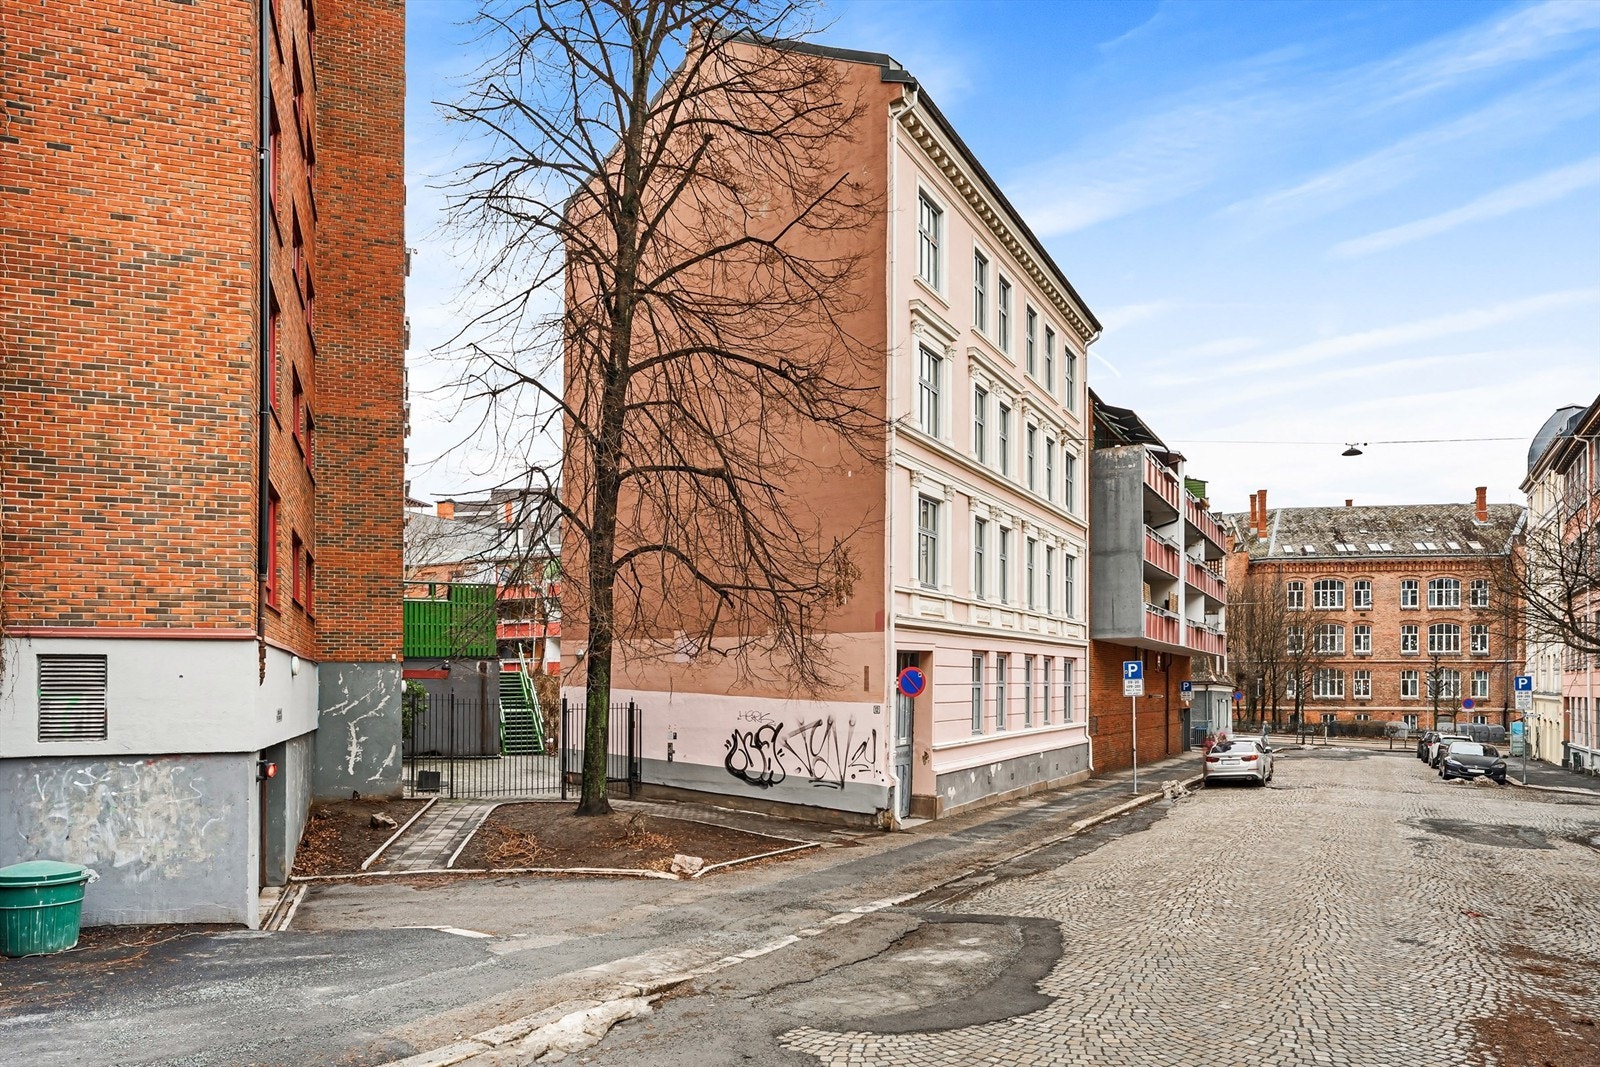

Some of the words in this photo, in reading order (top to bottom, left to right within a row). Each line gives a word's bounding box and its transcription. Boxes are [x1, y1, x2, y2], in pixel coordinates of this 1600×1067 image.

[1128, 664, 1138, 677] P
[1183, 682, 1189, 690] P
[1518, 678, 1528, 689] P
